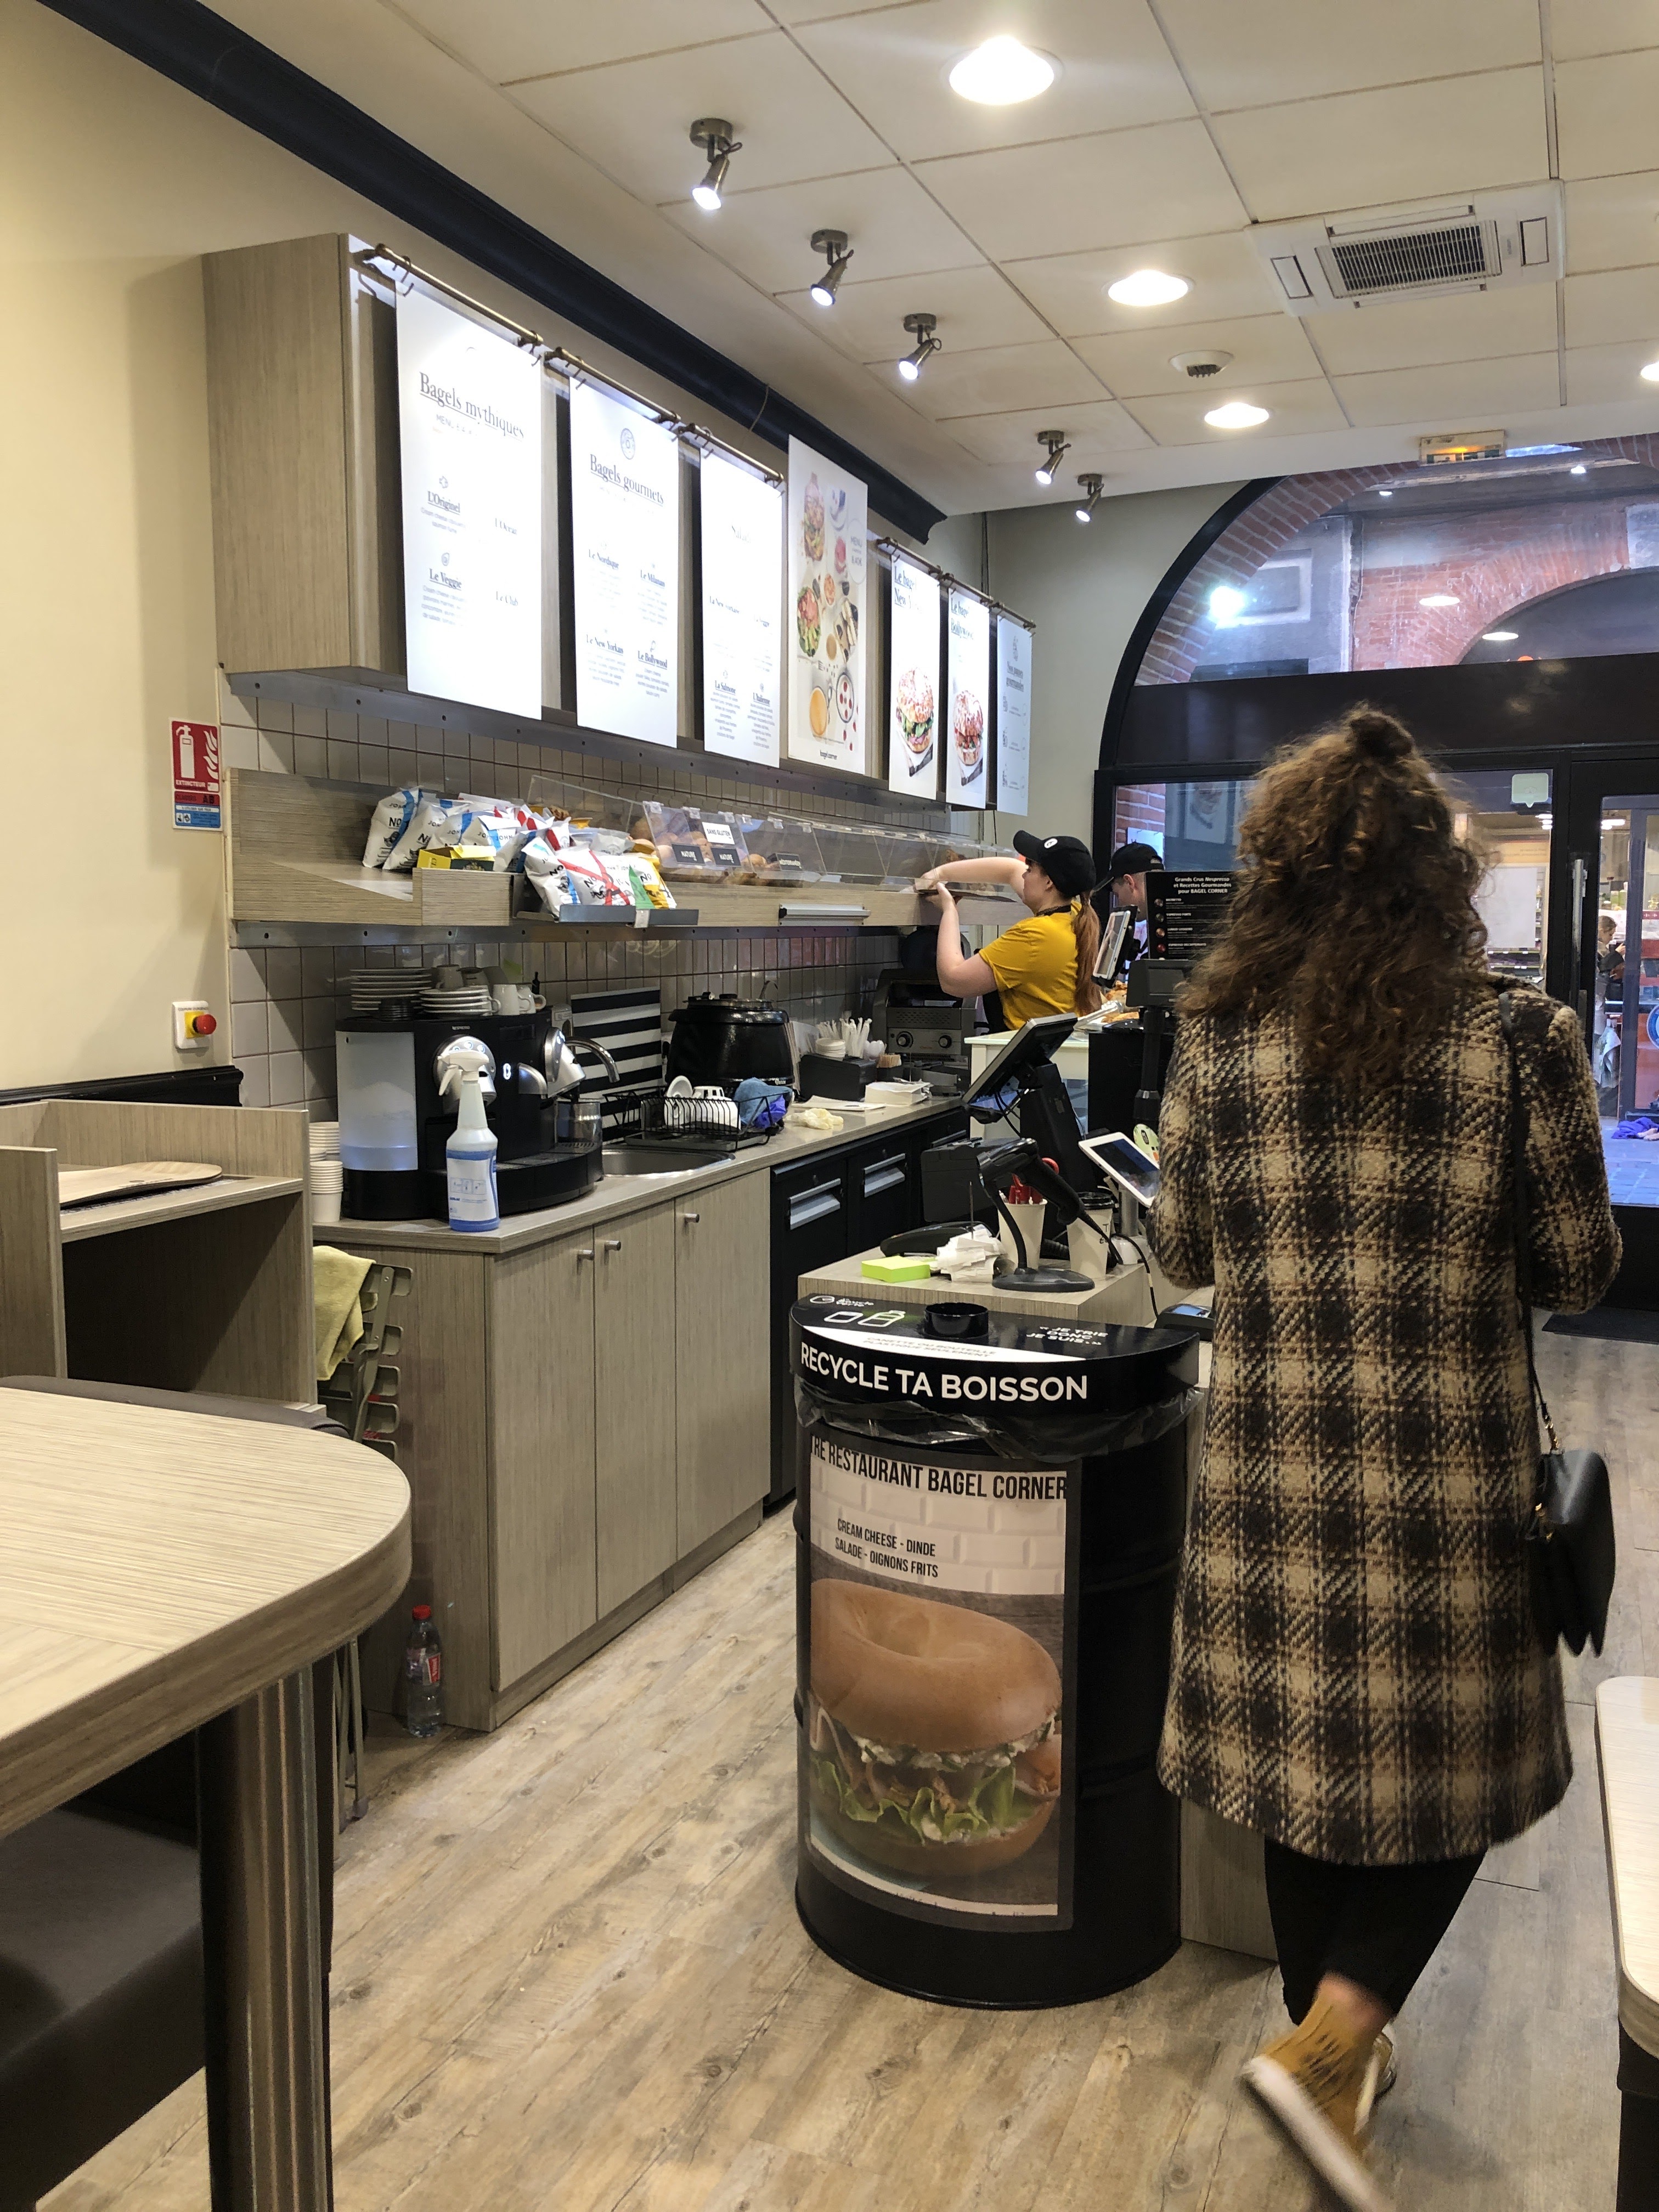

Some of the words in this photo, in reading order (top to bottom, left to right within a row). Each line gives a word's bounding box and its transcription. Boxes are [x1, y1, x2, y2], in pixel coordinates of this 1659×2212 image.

[420, 371, 462, 409] Bagels
[465, 402, 524, 437] mythiques
[590, 454, 621, 483] Bagels
[624, 476, 664, 504] gourmets
[429, 568, 439, 582] Le
[441, 572, 462, 589] Veggie
[894, 566, 902, 583] Le
[951, 597, 957, 613] Le
[638, 650, 644, 661] Le
[863, 1340, 922, 1349] PLASTIQUE
[923, 1347, 991, 1357] SEULEMENT
[867, 1337, 915, 1345] CANETTE
[936, 1345, 996, 1355] BOUTEILLE
[800, 1342, 889, 1391] RECYCLE
[895, 1368, 933, 1398] TA
[941, 1374, 1088, 1401] BOISSON
[828, 1443, 923, 1489] RESTAURANT
[928, 1468, 988, 1498] BAGEL
[993, 1475, 1067, 1500] CORNER
[837, 1518, 862, 1539] CREAM
[864, 1528, 898, 1550] CHEESE
[906, 1539, 936, 1557] DINDE
[835, 1537, 862, 1559] SALADE
[870, 1550, 909, 1572] OIGNONS
[911, 1561, 938, 1578] FRITS
